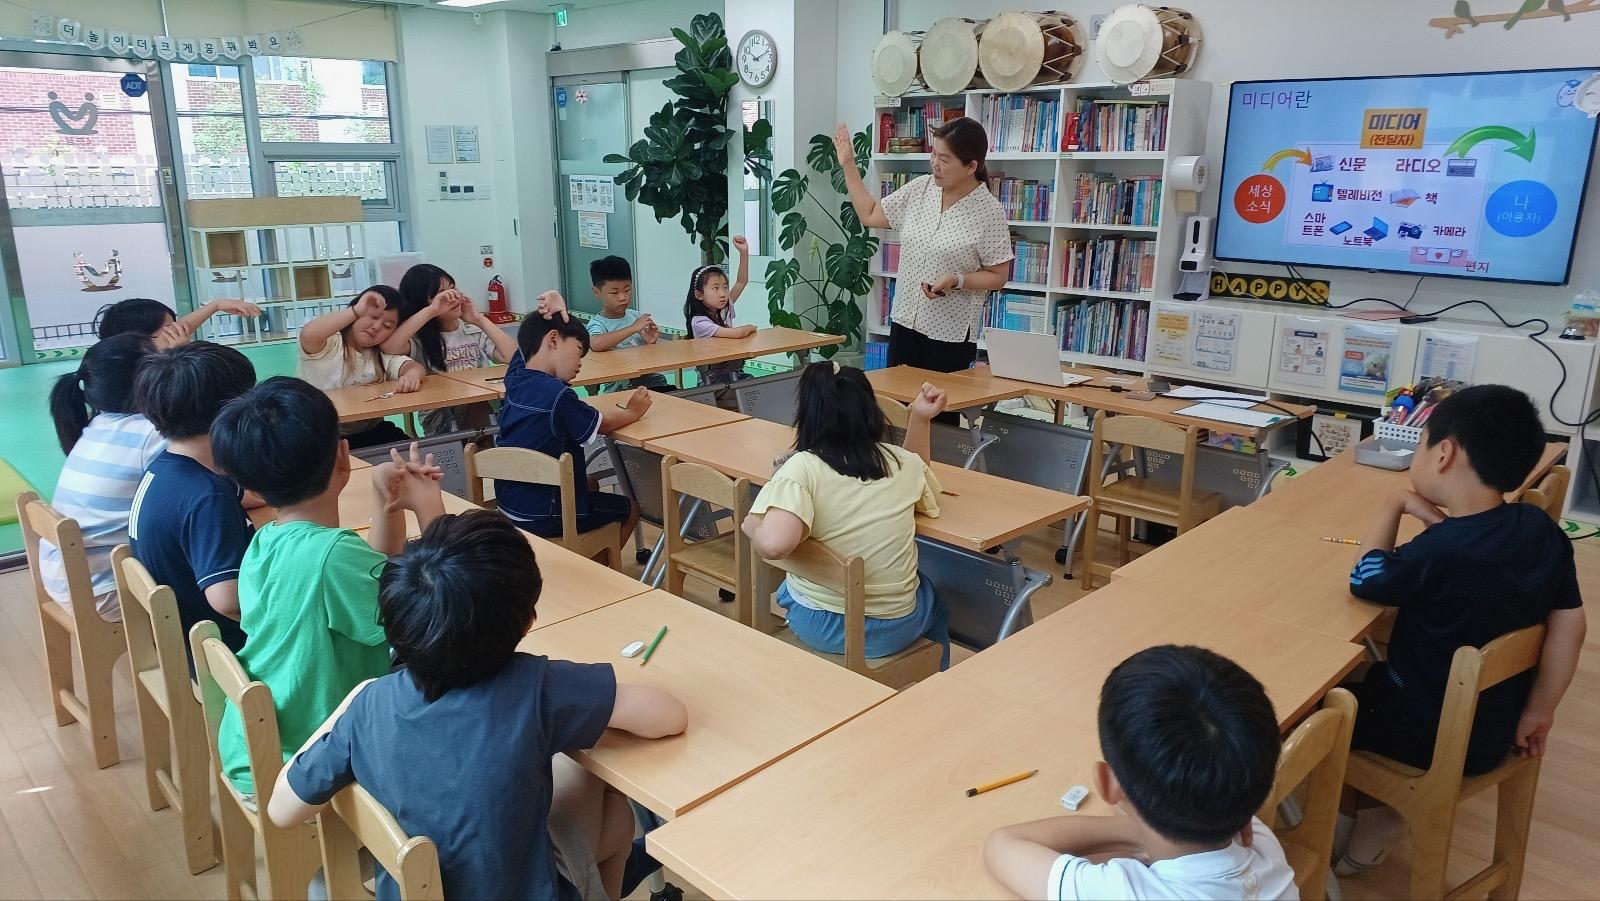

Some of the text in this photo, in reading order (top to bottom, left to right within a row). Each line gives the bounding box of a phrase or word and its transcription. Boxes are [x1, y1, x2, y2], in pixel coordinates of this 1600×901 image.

[126, 81, 142, 91] ADT
[1242, 90, 1312, 109] 미디어란
[1368, 113, 1422, 130] 미디어
[1369, 133, 1414, 147] (전달자)
[1339, 157, 1367, 172] 신문
[1395, 157, 1442, 173] 라디오
[1247, 184, 1274, 199] 세상
[1336, 188, 1383, 202] 텔레비전
[1425, 192, 1438, 205] 책
[1246, 199, 1271, 214] 소식
[1514, 194, 1531, 210] 나
[1303, 212, 1326, 224] 스마
[1497, 211, 1541, 223] (이용자)
[1301, 225, 1325, 237] 트폰
[1432, 225, 1467, 238] 카메라
[1343, 236, 1373, 247] 노트북
[1464, 260, 1490, 273] 편지
[1214, 279, 1303, 297] HAPPY
